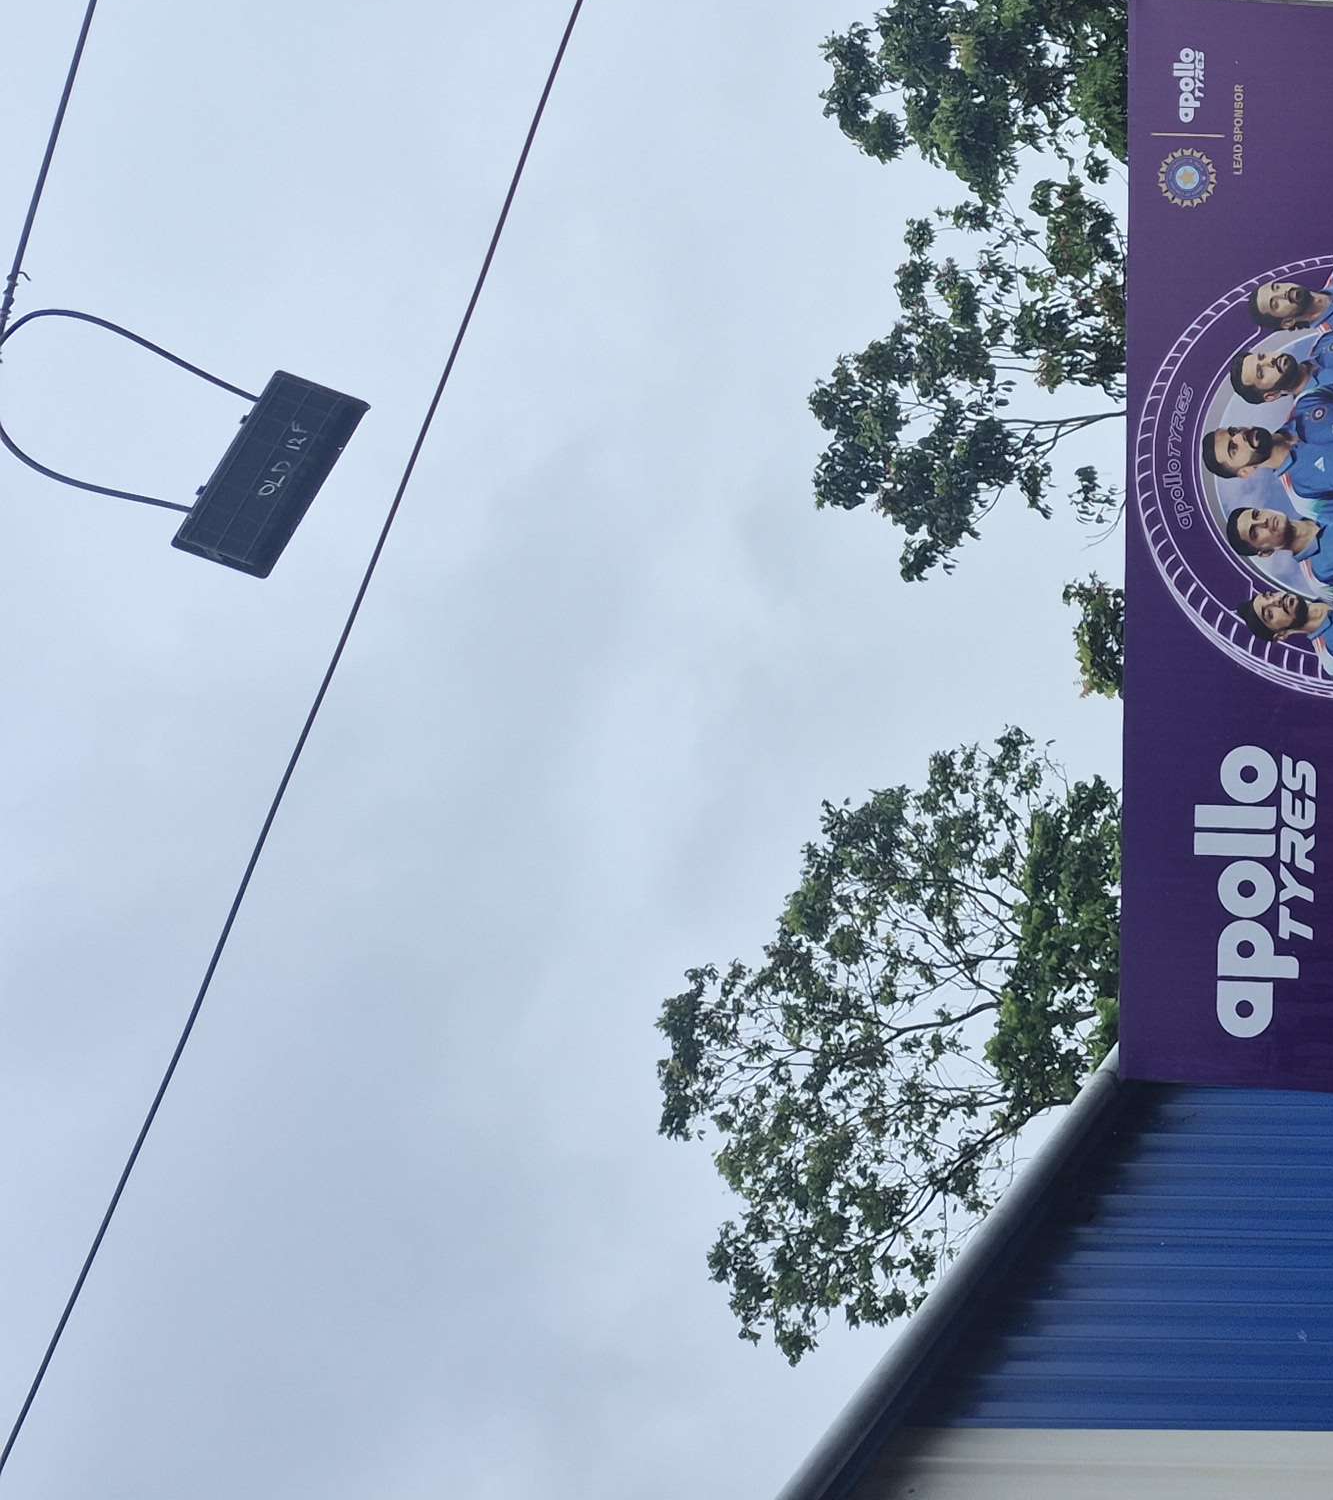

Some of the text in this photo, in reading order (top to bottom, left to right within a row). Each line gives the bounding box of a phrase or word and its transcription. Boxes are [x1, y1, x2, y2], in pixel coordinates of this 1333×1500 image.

[1172, 47, 1201, 124] apollo
[1194, 50, 1205, 98] TYRES
[1232, 83, 1245, 176] LEAD SPONSOR
[1161, 382, 1195, 528] apollo TYRES
[1193, 745, 1300, 1039] apollo
[1278, 753, 1317, 942] TYRES
